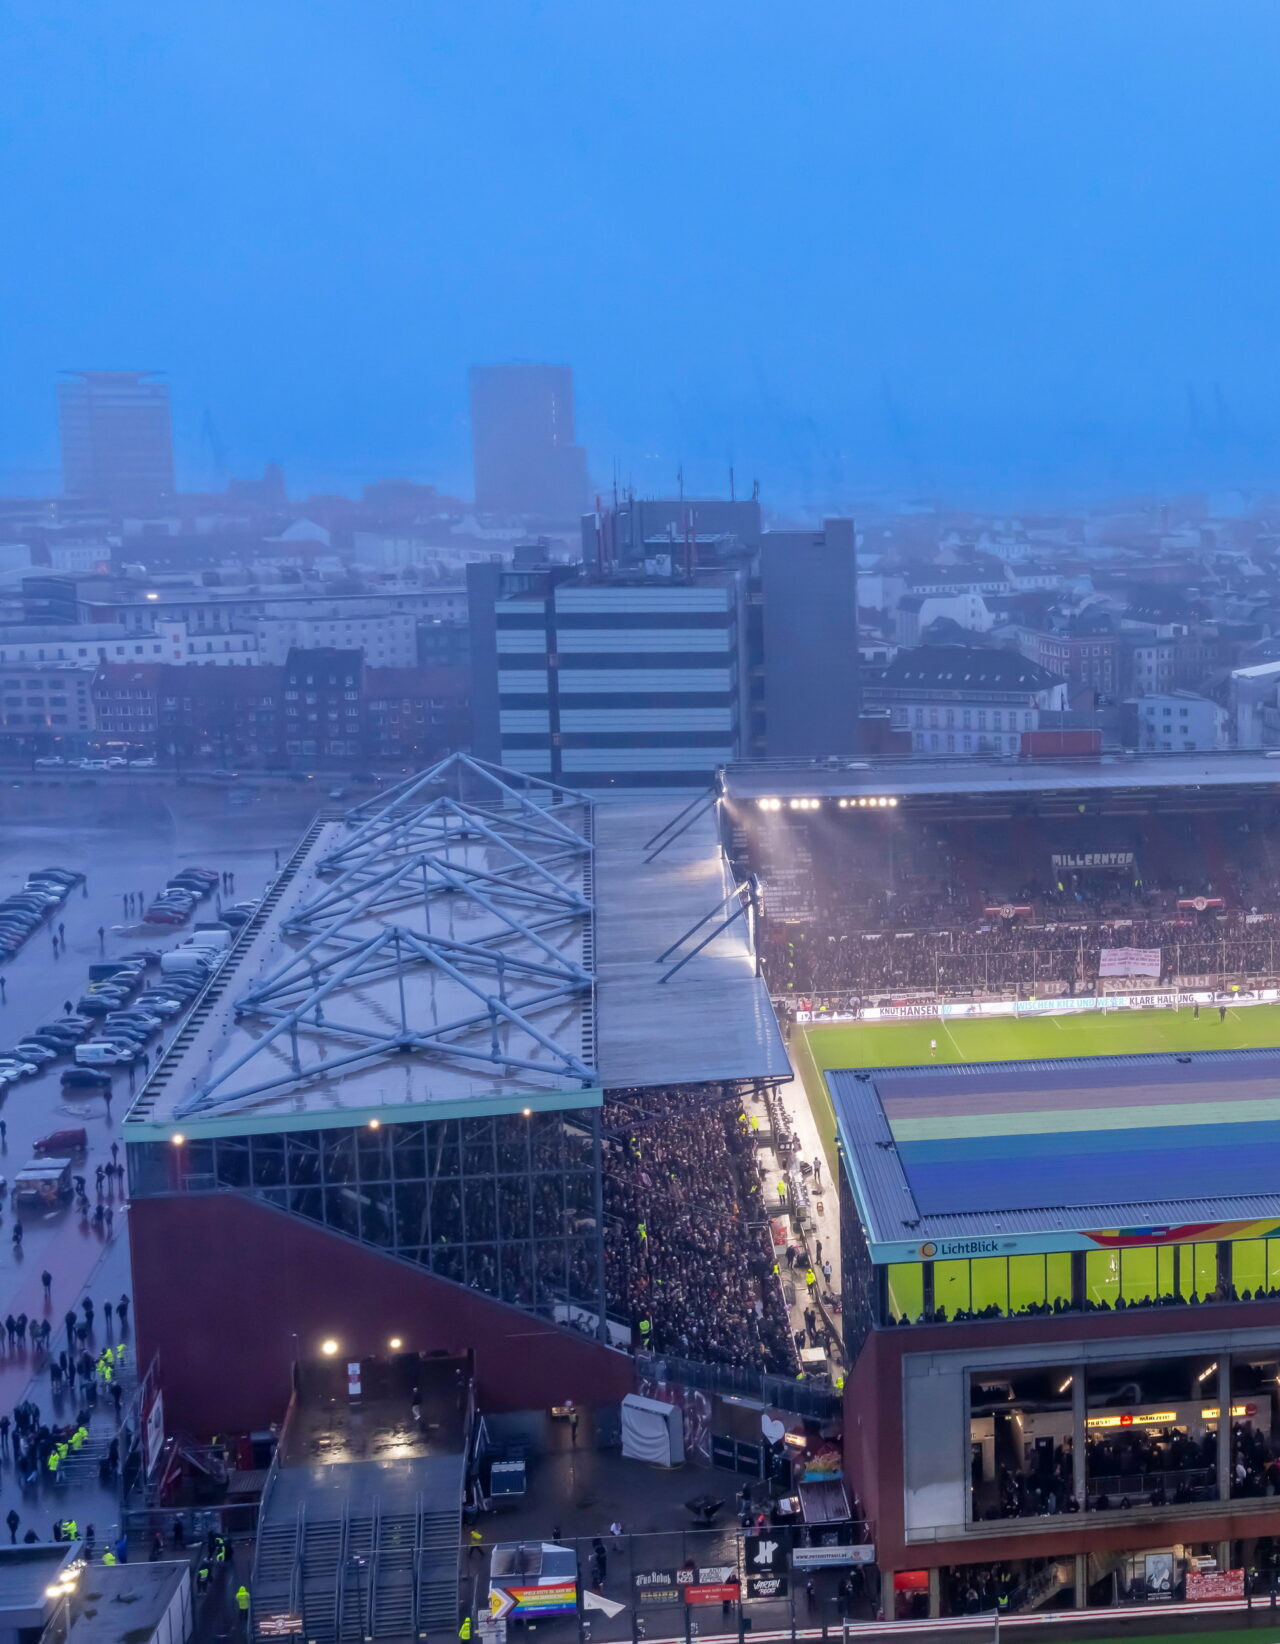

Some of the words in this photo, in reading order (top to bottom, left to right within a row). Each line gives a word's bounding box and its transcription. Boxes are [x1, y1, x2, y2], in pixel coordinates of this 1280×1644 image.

[1051, 853, 1134, 866] MILLERNTOR
[1129, 996, 1156, 1006] KLARE
[900, 1005, 939, 1016] HANSEN
[941, 1240, 999, 1255] LichtBlick
